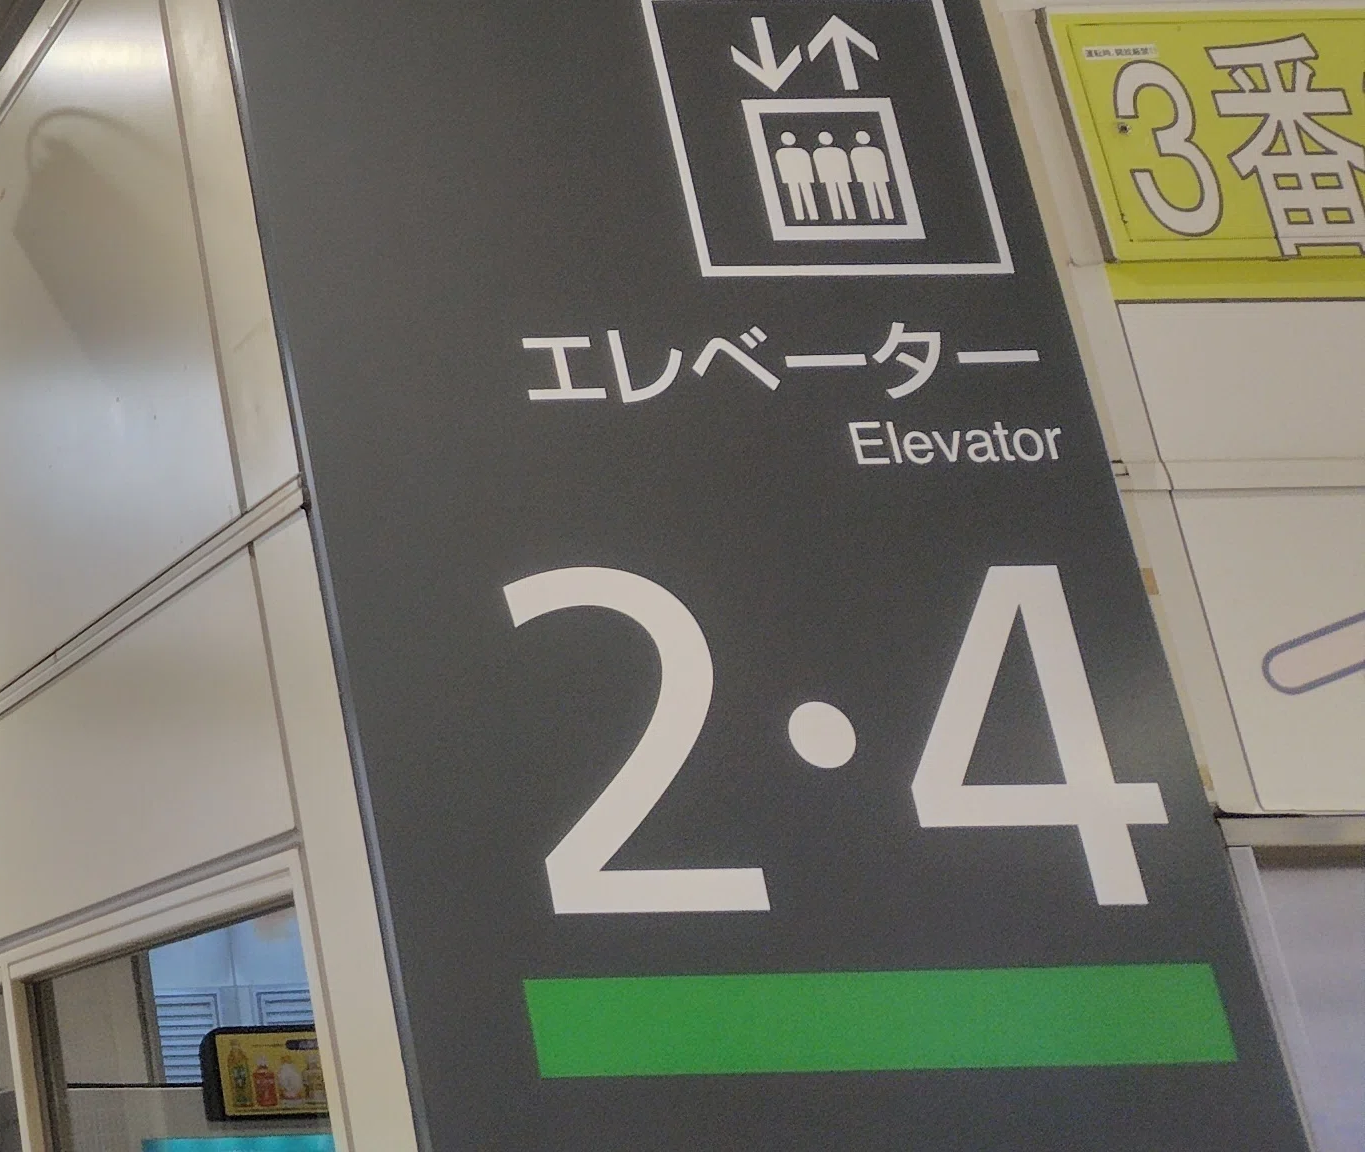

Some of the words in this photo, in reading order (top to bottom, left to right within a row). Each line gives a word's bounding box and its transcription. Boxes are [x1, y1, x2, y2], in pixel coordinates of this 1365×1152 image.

[522, 320, 1041, 404] エレベーター
[848, 420, 1062, 466] Elevator
